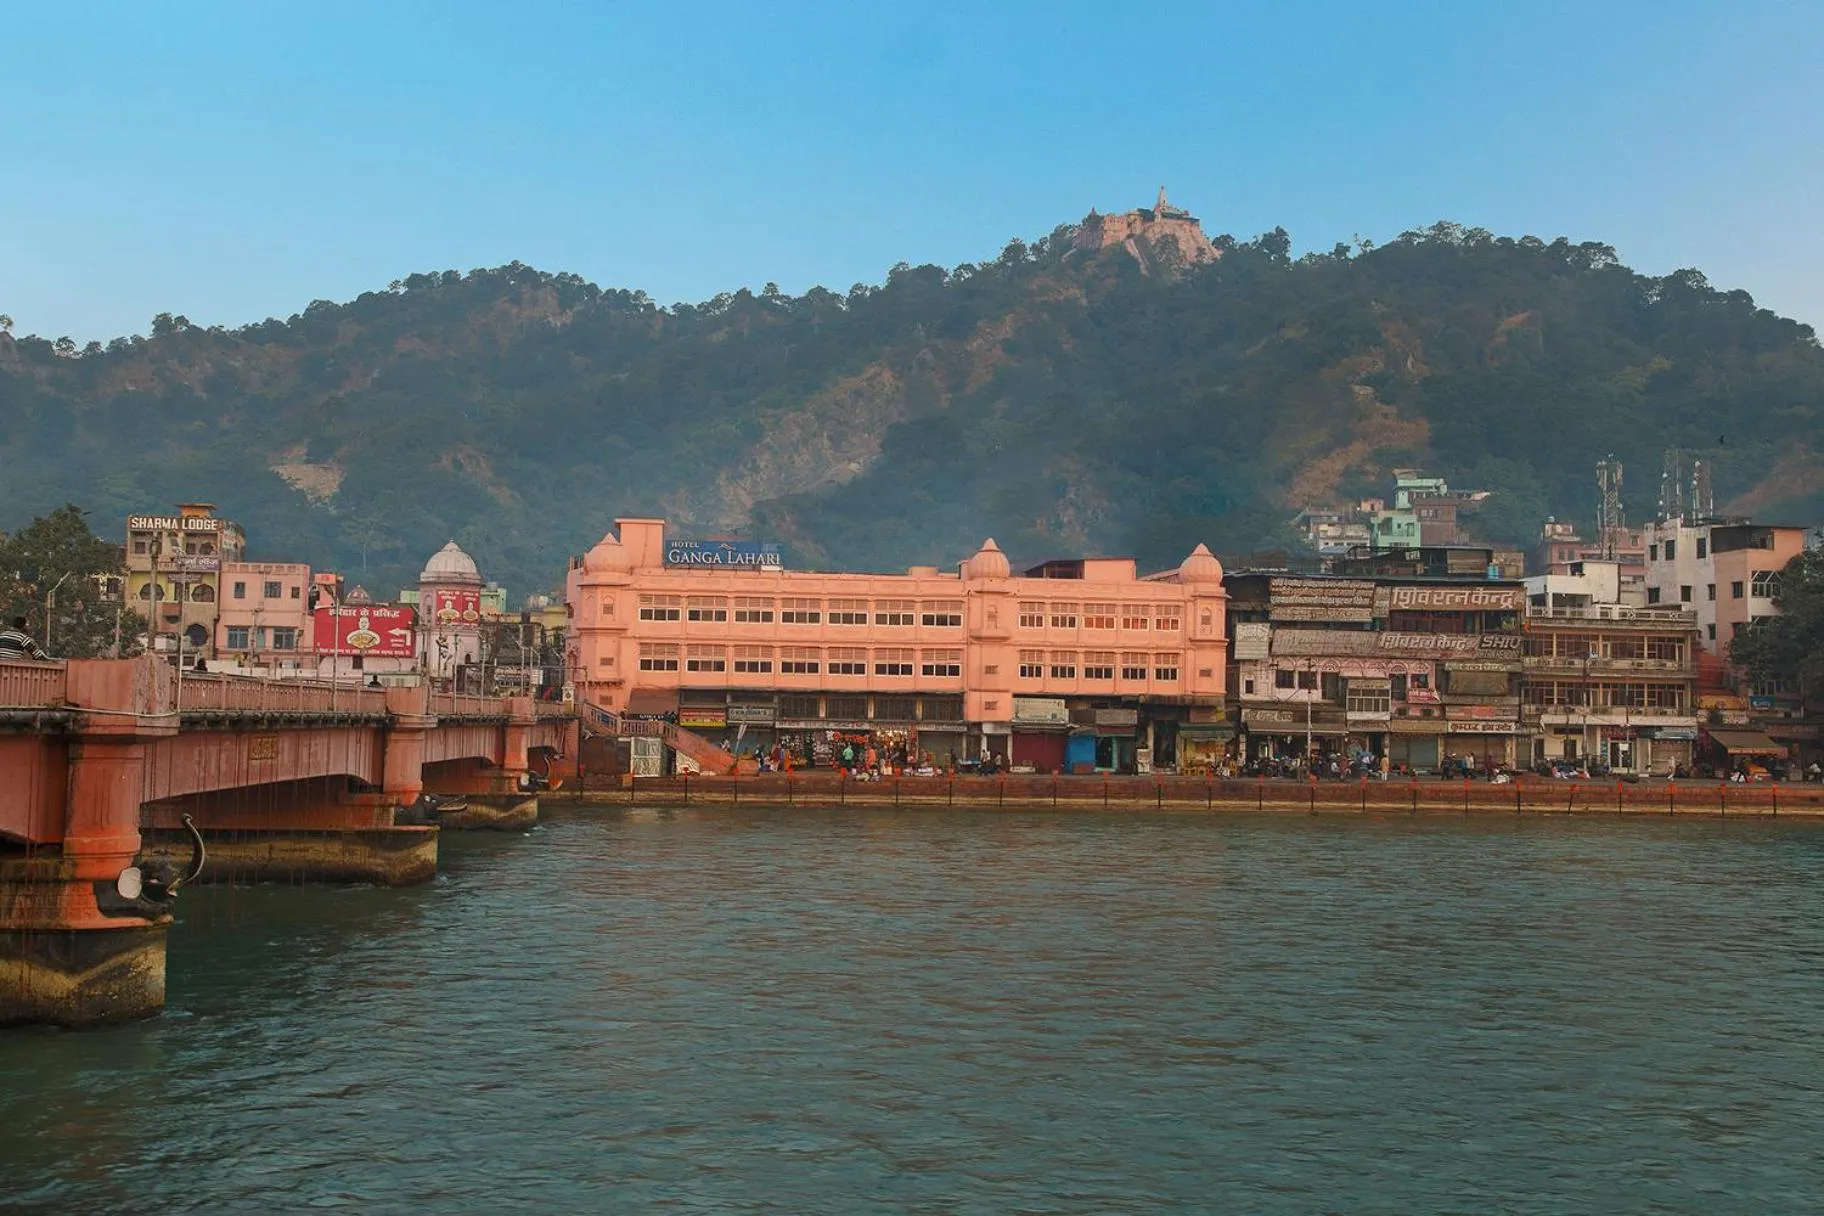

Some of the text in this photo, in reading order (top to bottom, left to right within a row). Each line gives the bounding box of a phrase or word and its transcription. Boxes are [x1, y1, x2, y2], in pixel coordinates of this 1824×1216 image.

[131, 517, 217, 530] SHARMA LODGE
[668, 549, 780, 565] GANGA LAHARI
[1393, 587, 1430, 608] शिव
[1433, 590, 1471, 605] रत्न
[1471, 587, 1516, 609] केन्द्र
